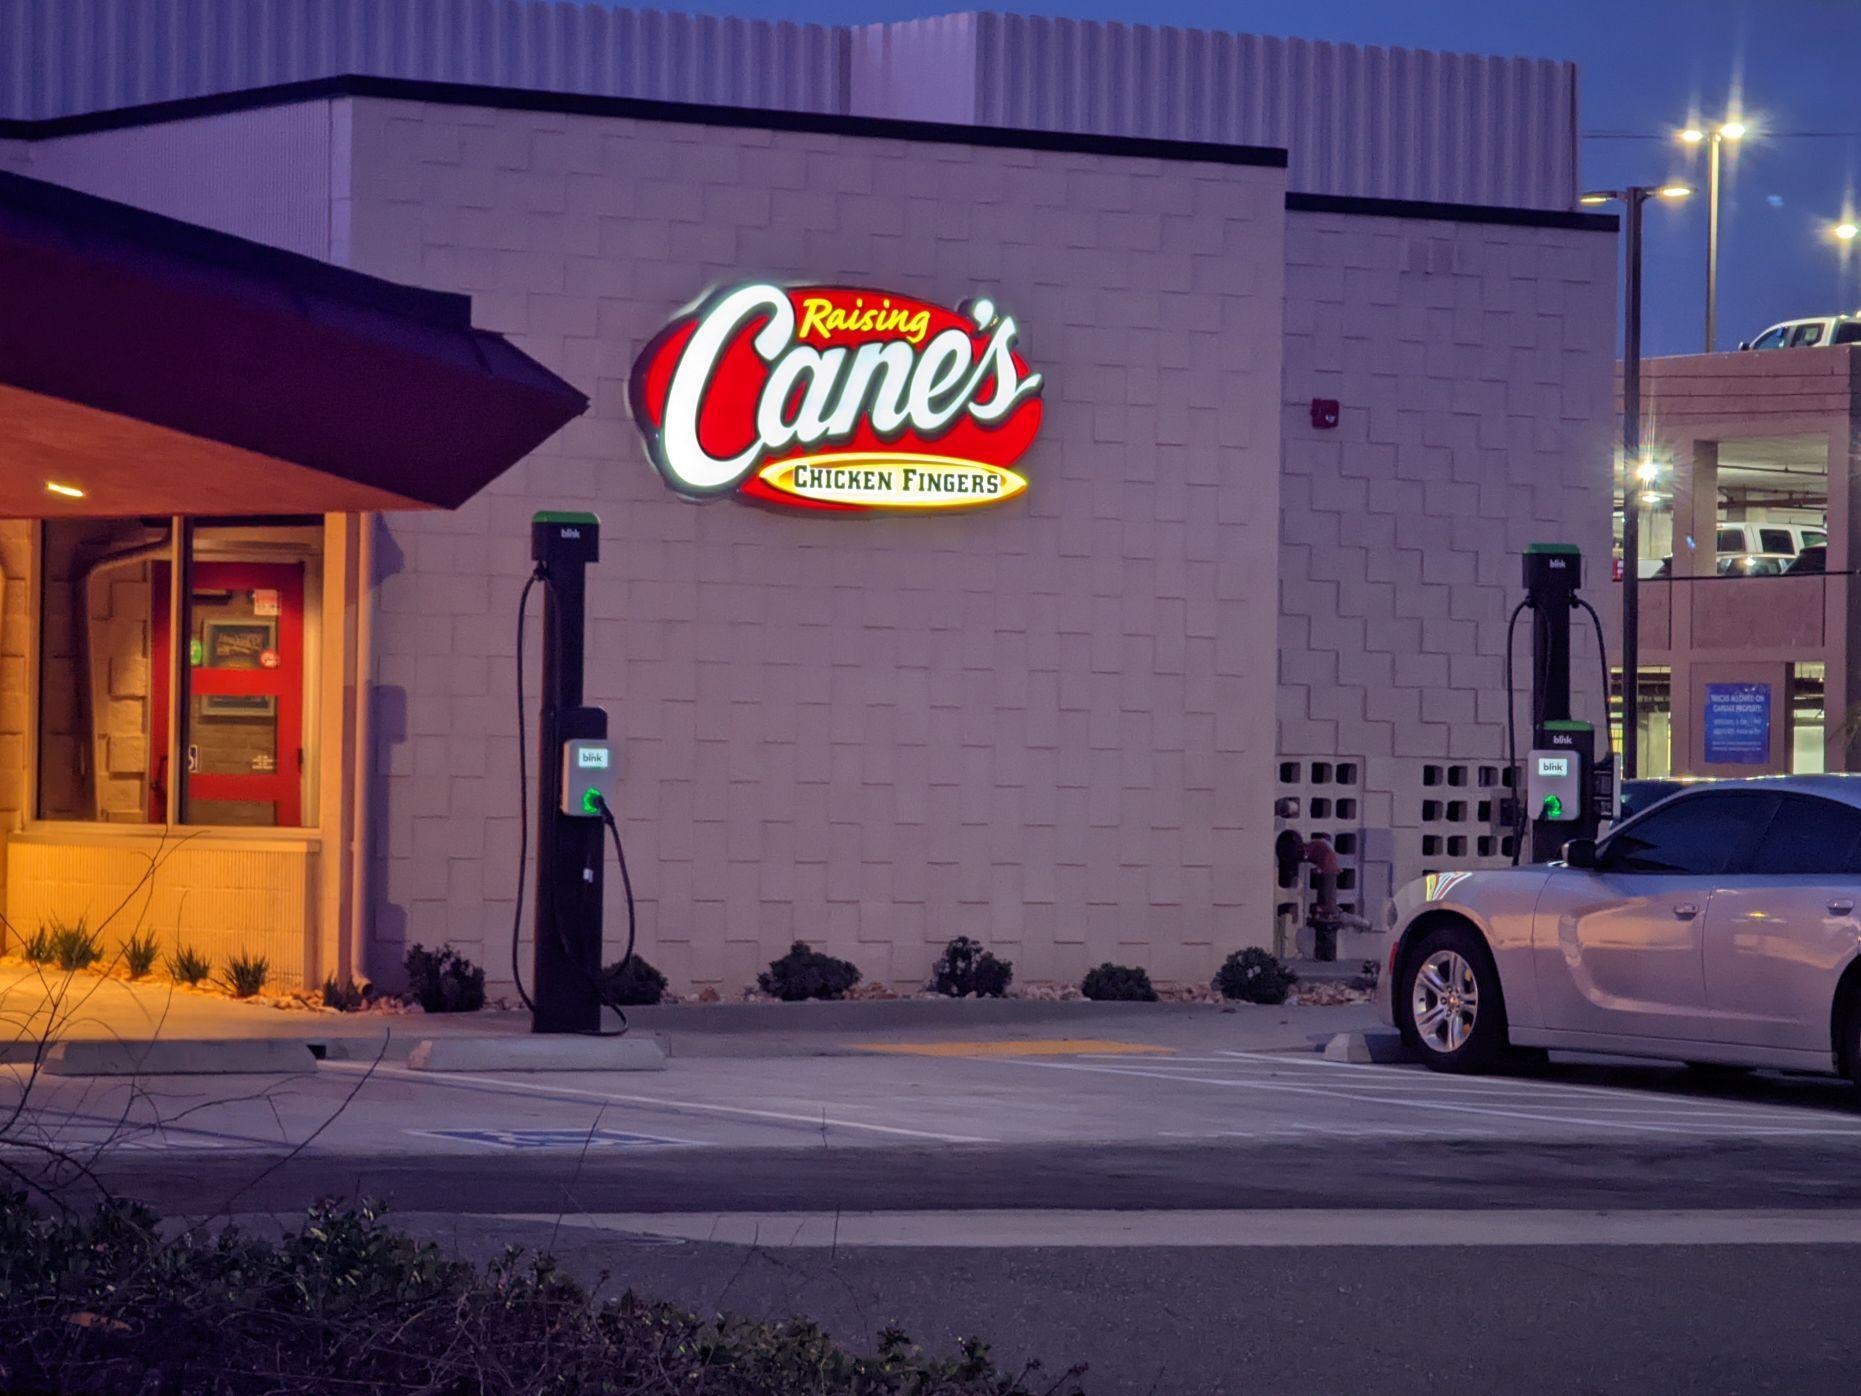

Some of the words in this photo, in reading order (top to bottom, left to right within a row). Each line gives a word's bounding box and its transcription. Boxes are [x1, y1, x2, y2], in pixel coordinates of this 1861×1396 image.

[799, 298, 931, 343] Raising
[664, 284, 1043, 487] Cane's
[1553, 735, 1573, 745] blink
[582, 752, 602, 762] blink
[1543, 762, 1563, 771] blink
